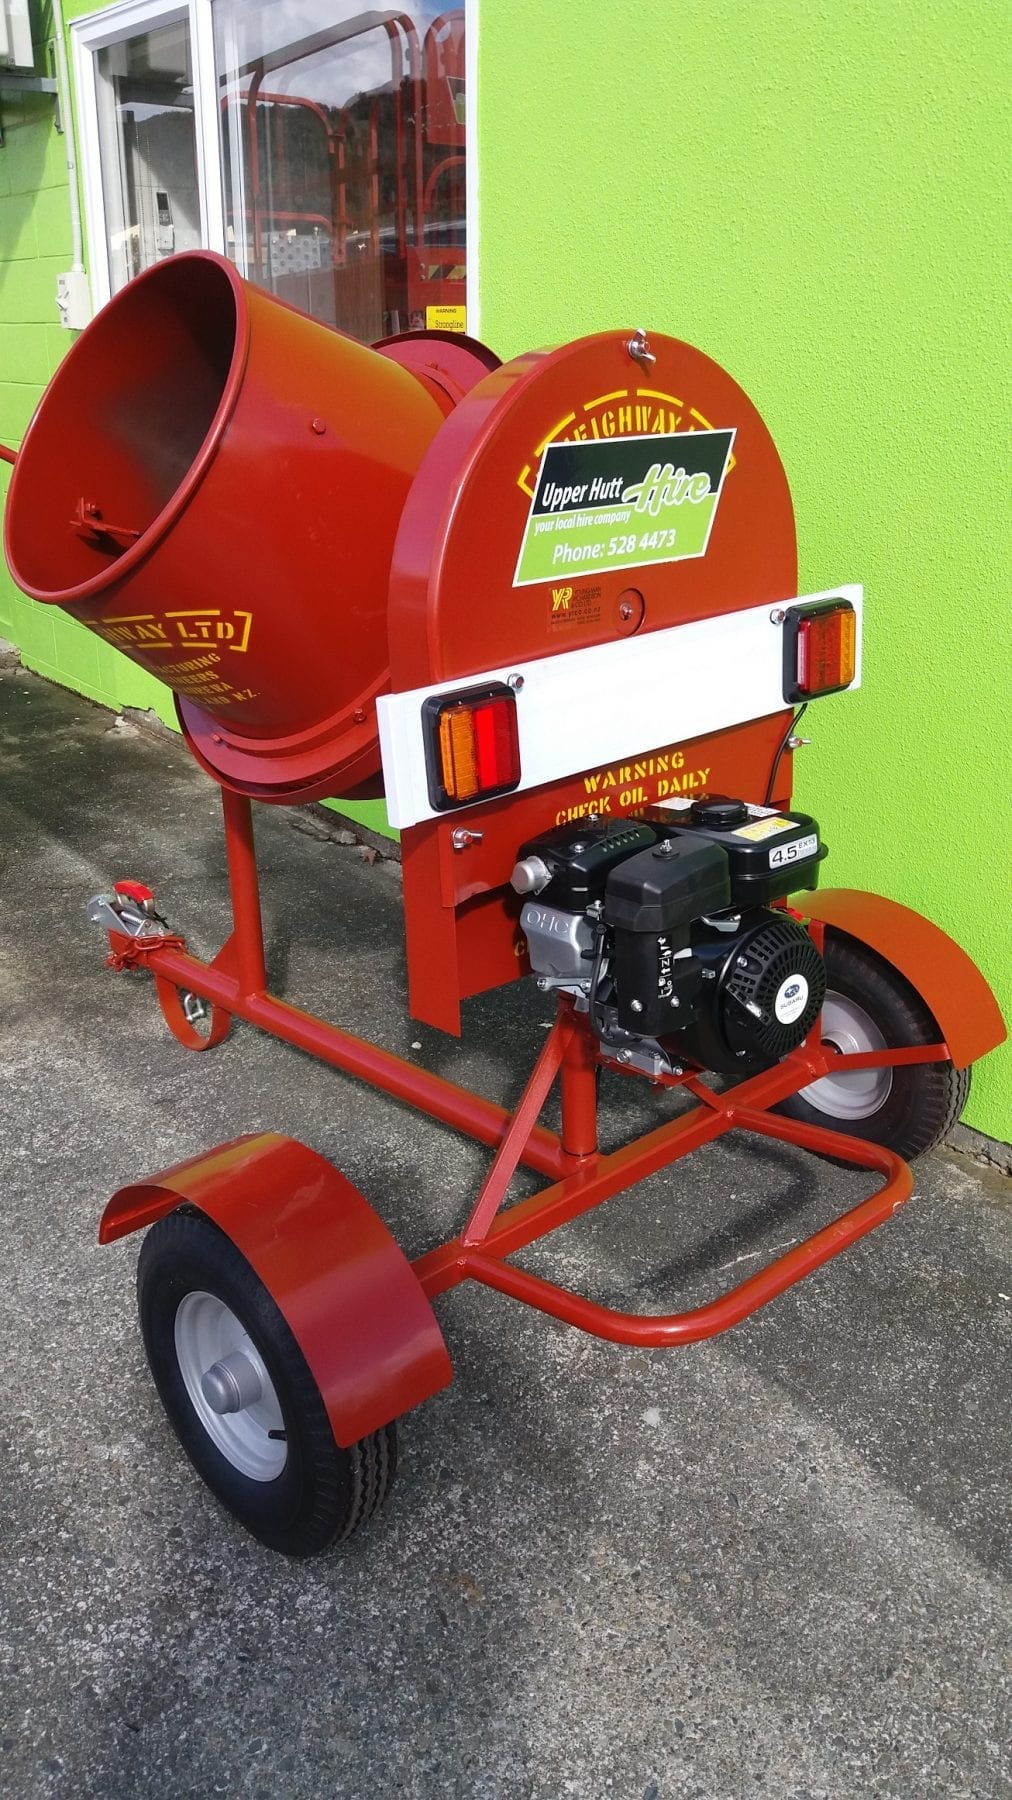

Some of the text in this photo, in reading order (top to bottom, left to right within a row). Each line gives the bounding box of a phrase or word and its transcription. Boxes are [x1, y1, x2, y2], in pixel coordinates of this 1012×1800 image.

[541, 463, 711, 516] Upper Hutt Hire
[534, 510, 632, 537] your local hire company
[552, 528, 677, 565] Phone: 528 4473
[176, 621, 235, 639] LTD
[583, 751, 685, 794] WARNING
[555, 767, 711, 826] CHECK OIL DAILY
[772, 845, 798, 863] 4.5
[526, 910, 569, 934] OHC
[780, 995, 804, 1010] SUBARU
